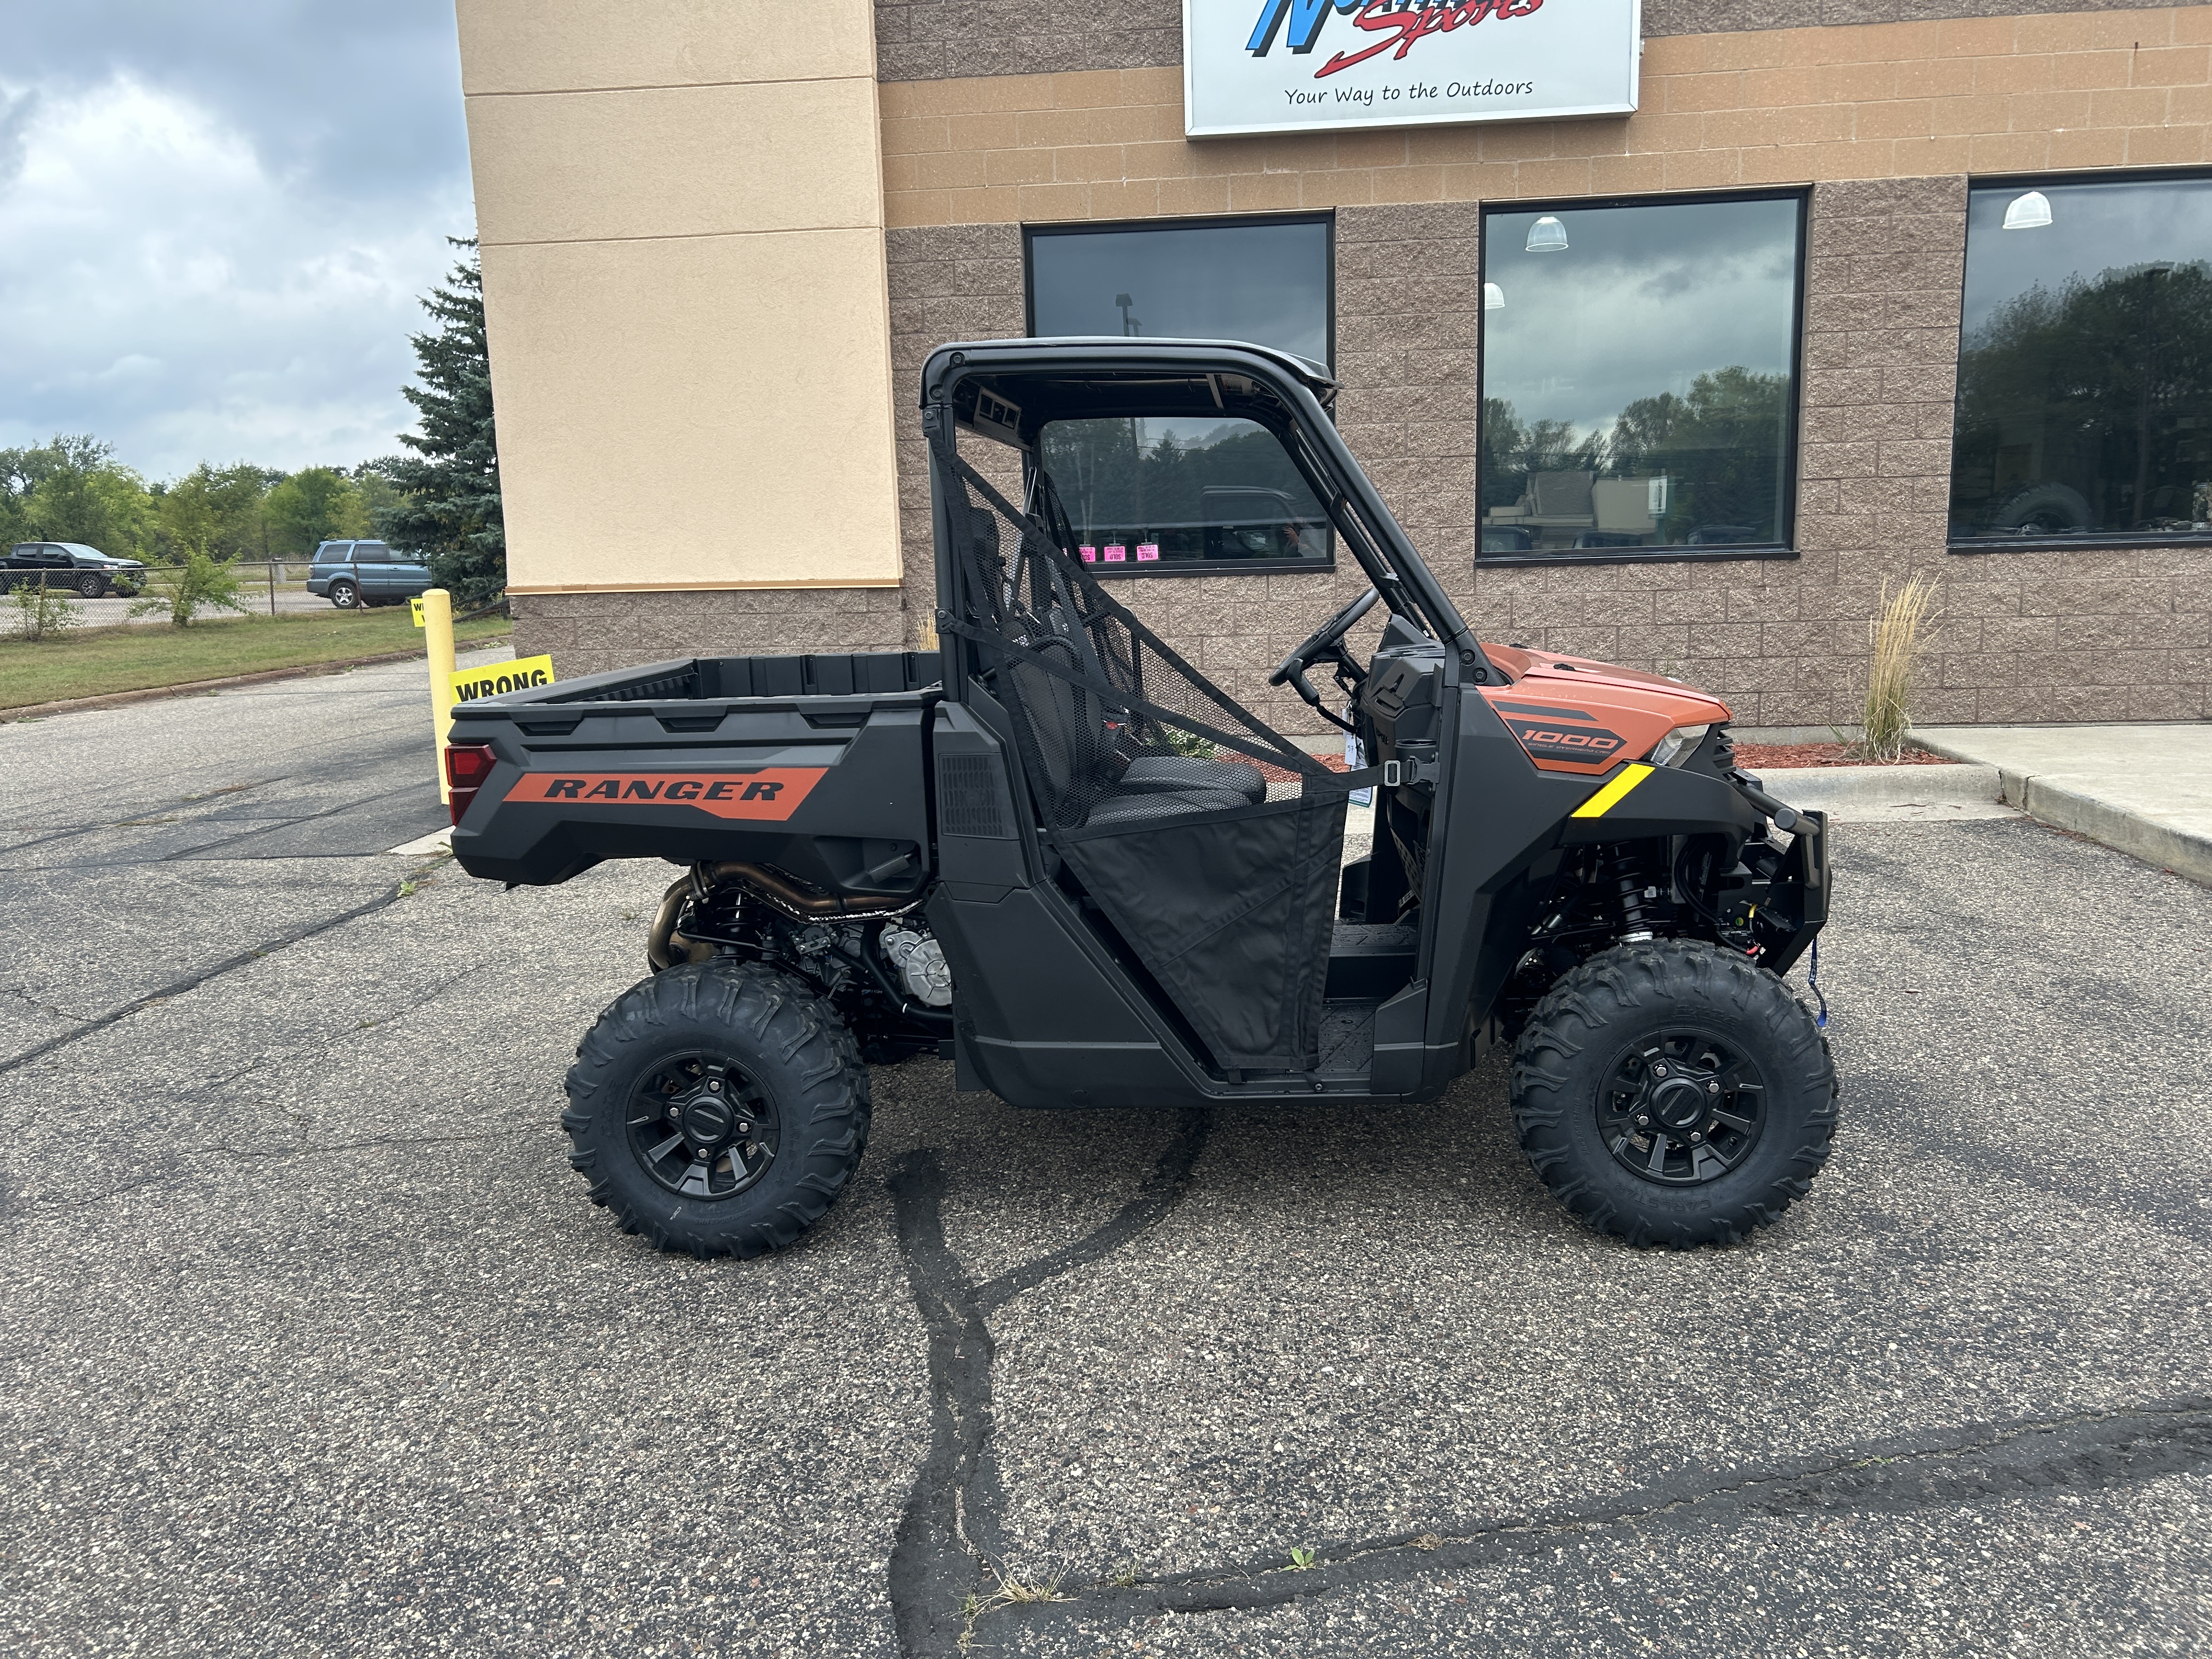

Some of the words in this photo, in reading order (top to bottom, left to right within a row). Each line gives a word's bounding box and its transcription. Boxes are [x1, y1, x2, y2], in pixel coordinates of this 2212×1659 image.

[1284, 88, 1328, 105] Your
[1335, 86, 1374, 106] Way
[1381, 85, 1401, 100] to
[1409, 82, 1438, 99] the
[1446, 78, 1533, 98] Outdoors
[455, 669, 548, 703] WRONG
[1522, 729, 1618, 749] 1000
[1556, 744, 1594, 753] OVERHEAD
[543, 778, 785, 801] RANGER
[1614, 1182, 1712, 1214] CARLSTAR
